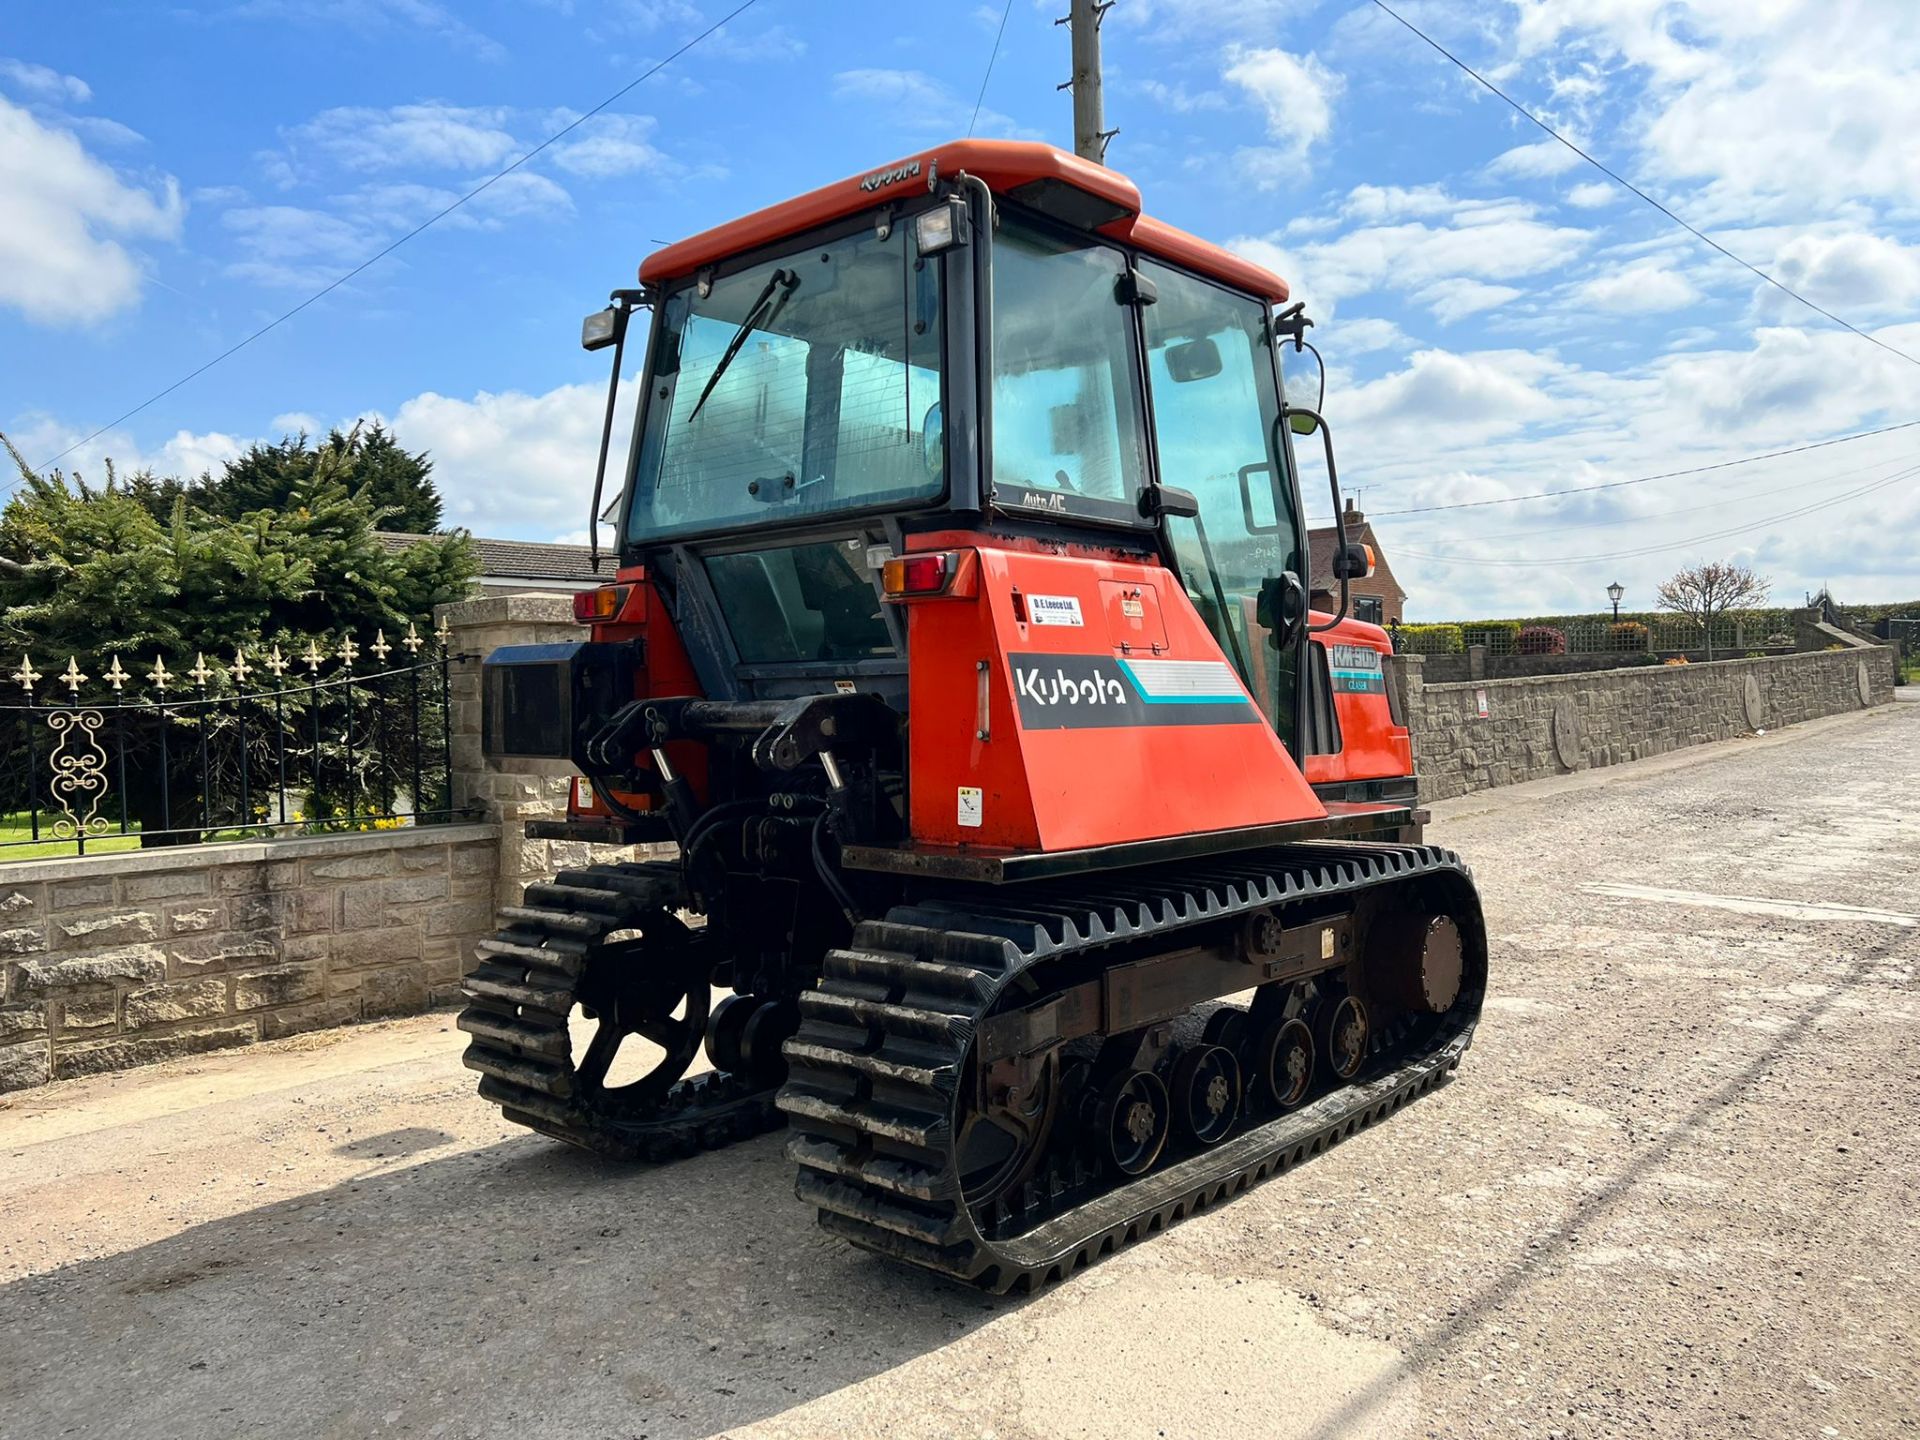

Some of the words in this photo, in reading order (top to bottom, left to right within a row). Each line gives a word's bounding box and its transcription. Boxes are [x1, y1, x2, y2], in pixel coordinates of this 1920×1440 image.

[860, 160, 921, 192] Kubota
[1022, 492, 1047, 508] Auto
[1048, 493, 1066, 512] AC
[1016, 668, 1127, 705] Kubota
